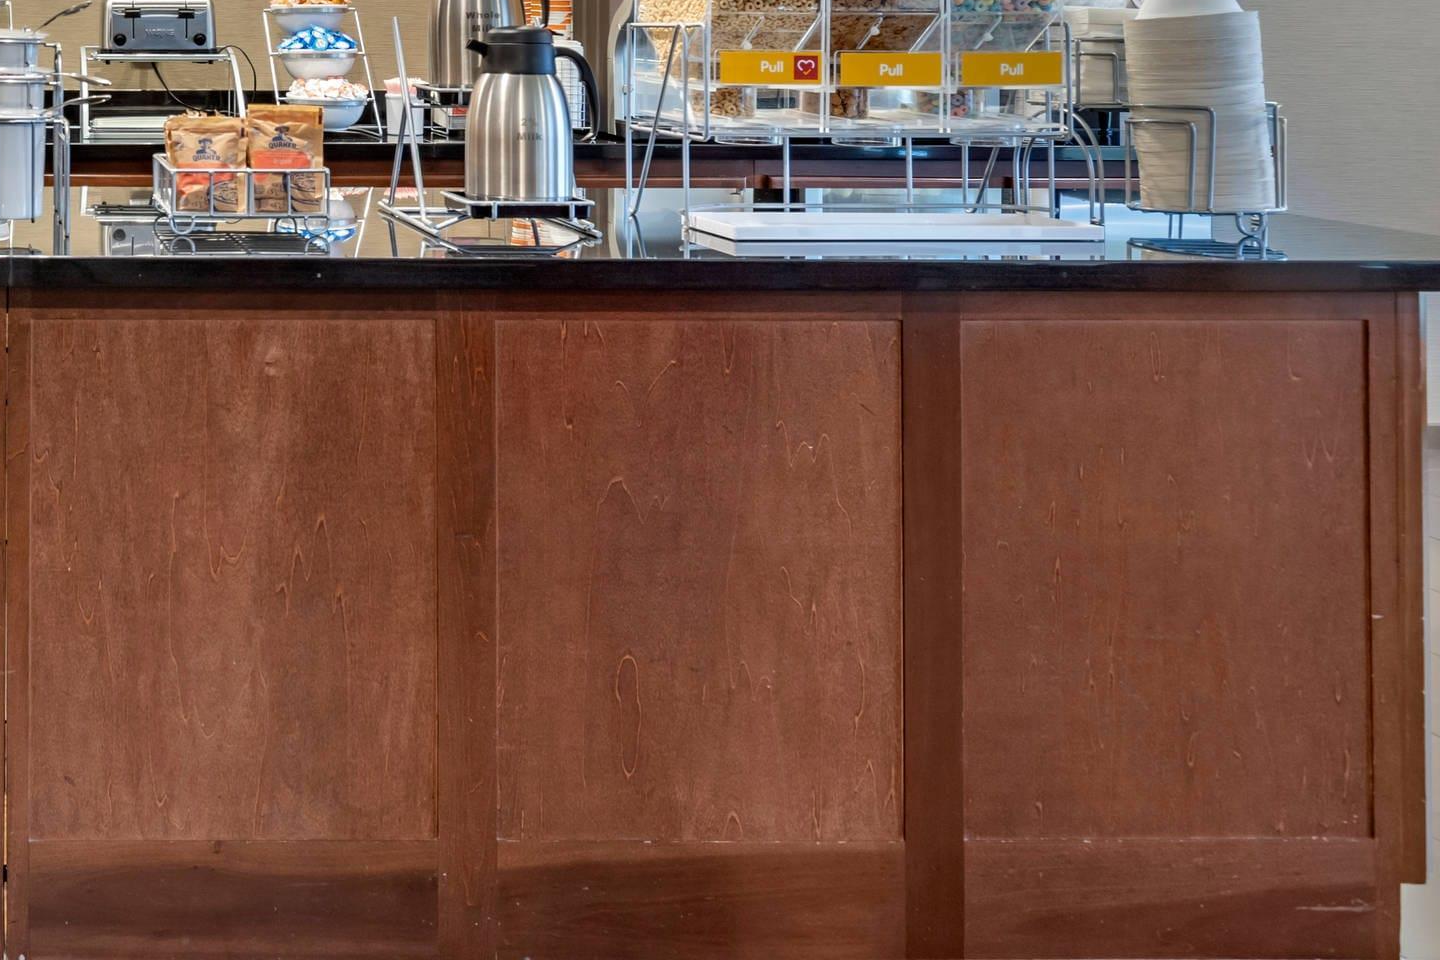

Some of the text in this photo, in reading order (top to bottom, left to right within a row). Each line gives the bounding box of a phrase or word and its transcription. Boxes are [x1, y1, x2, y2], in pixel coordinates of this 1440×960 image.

[465, 11, 500, 19] Whole
[760, 61, 784, 73] Pull
[879, 64, 903, 76] Pull
[1000, 63, 1024, 76] Pull
